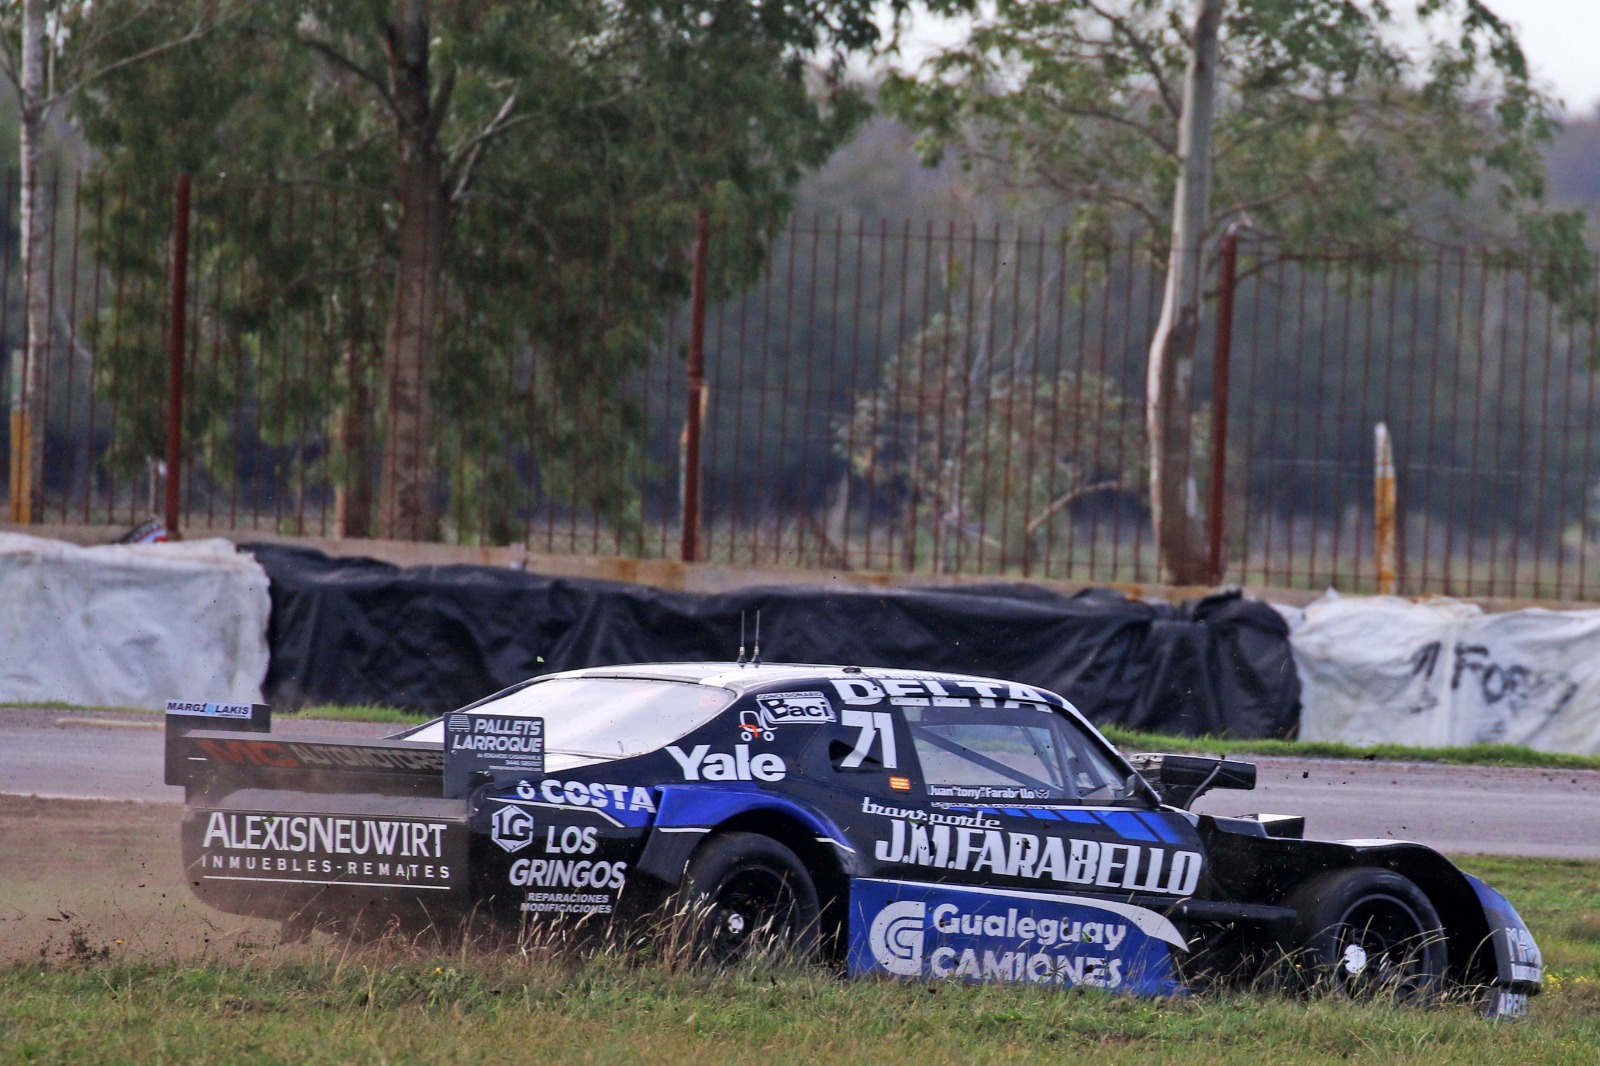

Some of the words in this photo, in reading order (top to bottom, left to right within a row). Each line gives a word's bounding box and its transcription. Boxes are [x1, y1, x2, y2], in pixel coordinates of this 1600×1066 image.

[760, 699, 831, 720] Baci
[829, 679, 1054, 713] DELTA
[474, 718, 542, 736] PALLETS
[840, 709, 897, 768] 71
[452, 734, 543, 753] LARROQUE
[664, 744, 786, 782] Yale
[540, 779, 656, 813] COSTA
[202, 812, 447, 858] ALEXISNEUWIRT
[545, 825, 598, 854] LOS
[508, 858, 627, 889] GRINGOS
[520, 902, 612, 913] MODIFICACIONES
[527, 892, 609, 903] REPARACIONES
[932, 903, 1127, 951] Gualeguay
[930, 946, 1122, 989] CAMIONES
